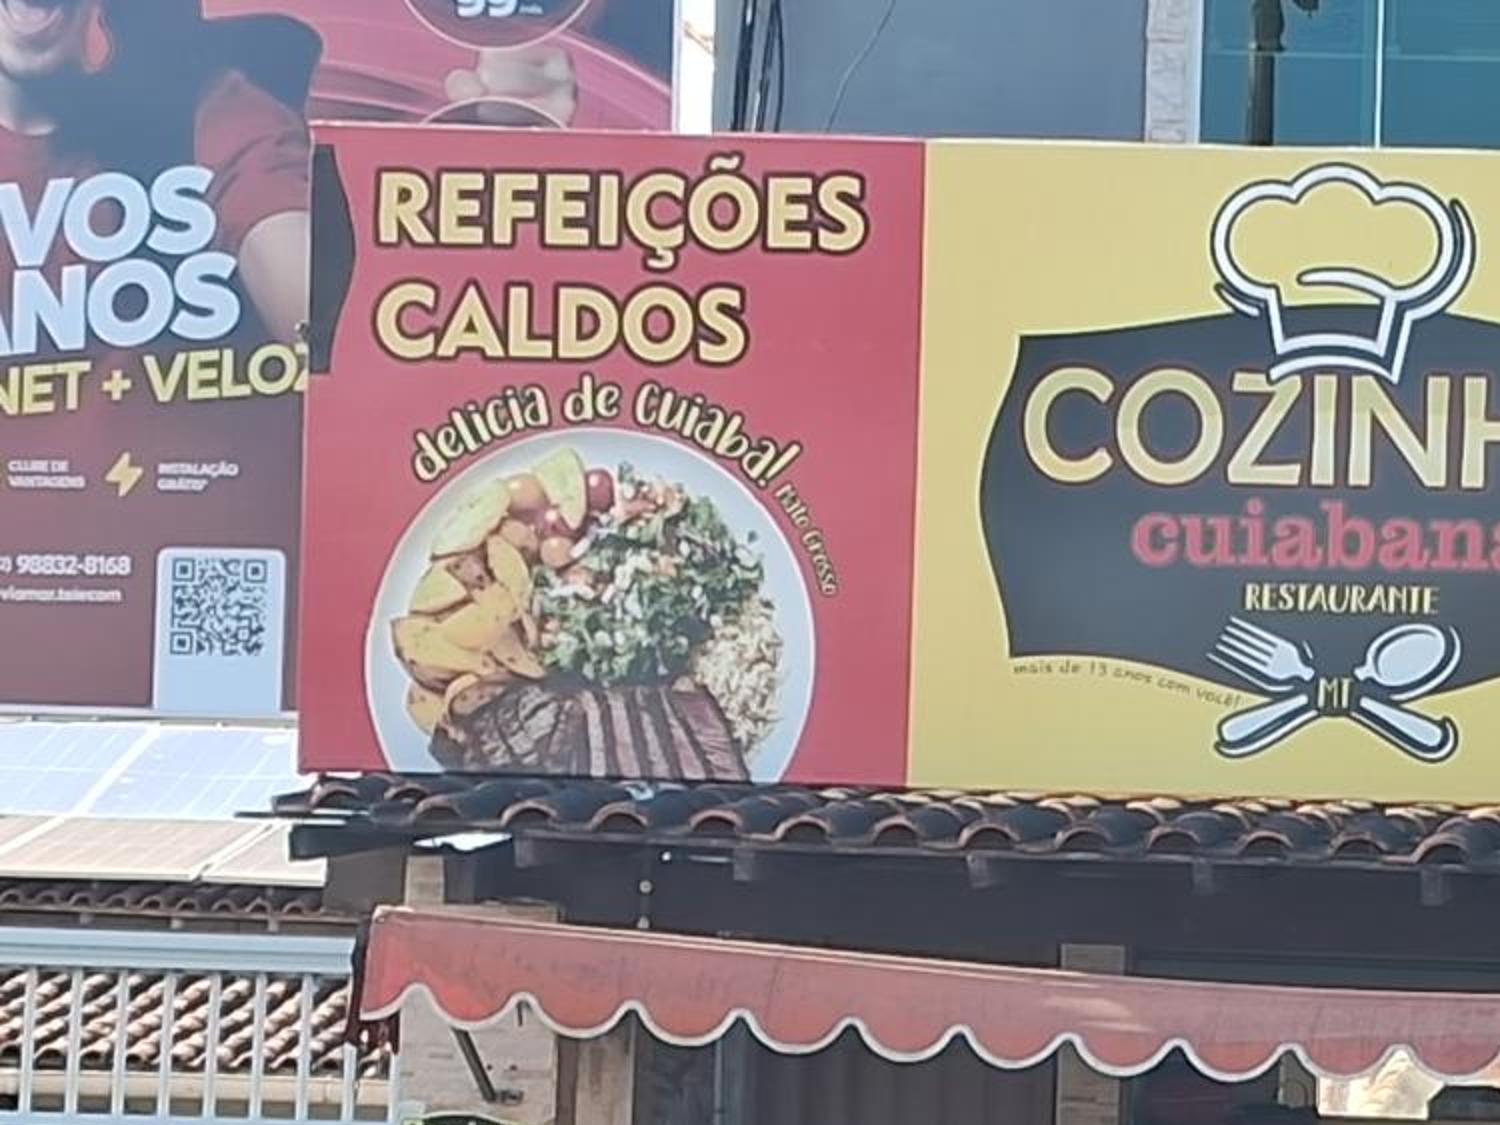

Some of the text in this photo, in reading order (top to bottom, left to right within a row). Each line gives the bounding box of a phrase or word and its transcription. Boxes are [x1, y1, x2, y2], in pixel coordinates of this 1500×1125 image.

[375, 152, 868, 270] REFEIÇÕES
[374, 281, 750, 365] CALDOS
[563, 373, 621, 422] de
[1245, 583, 1440, 614] RESTAURANTE
[1060, 660, 1079, 673] de
[1317, 678, 1354, 708] MT
